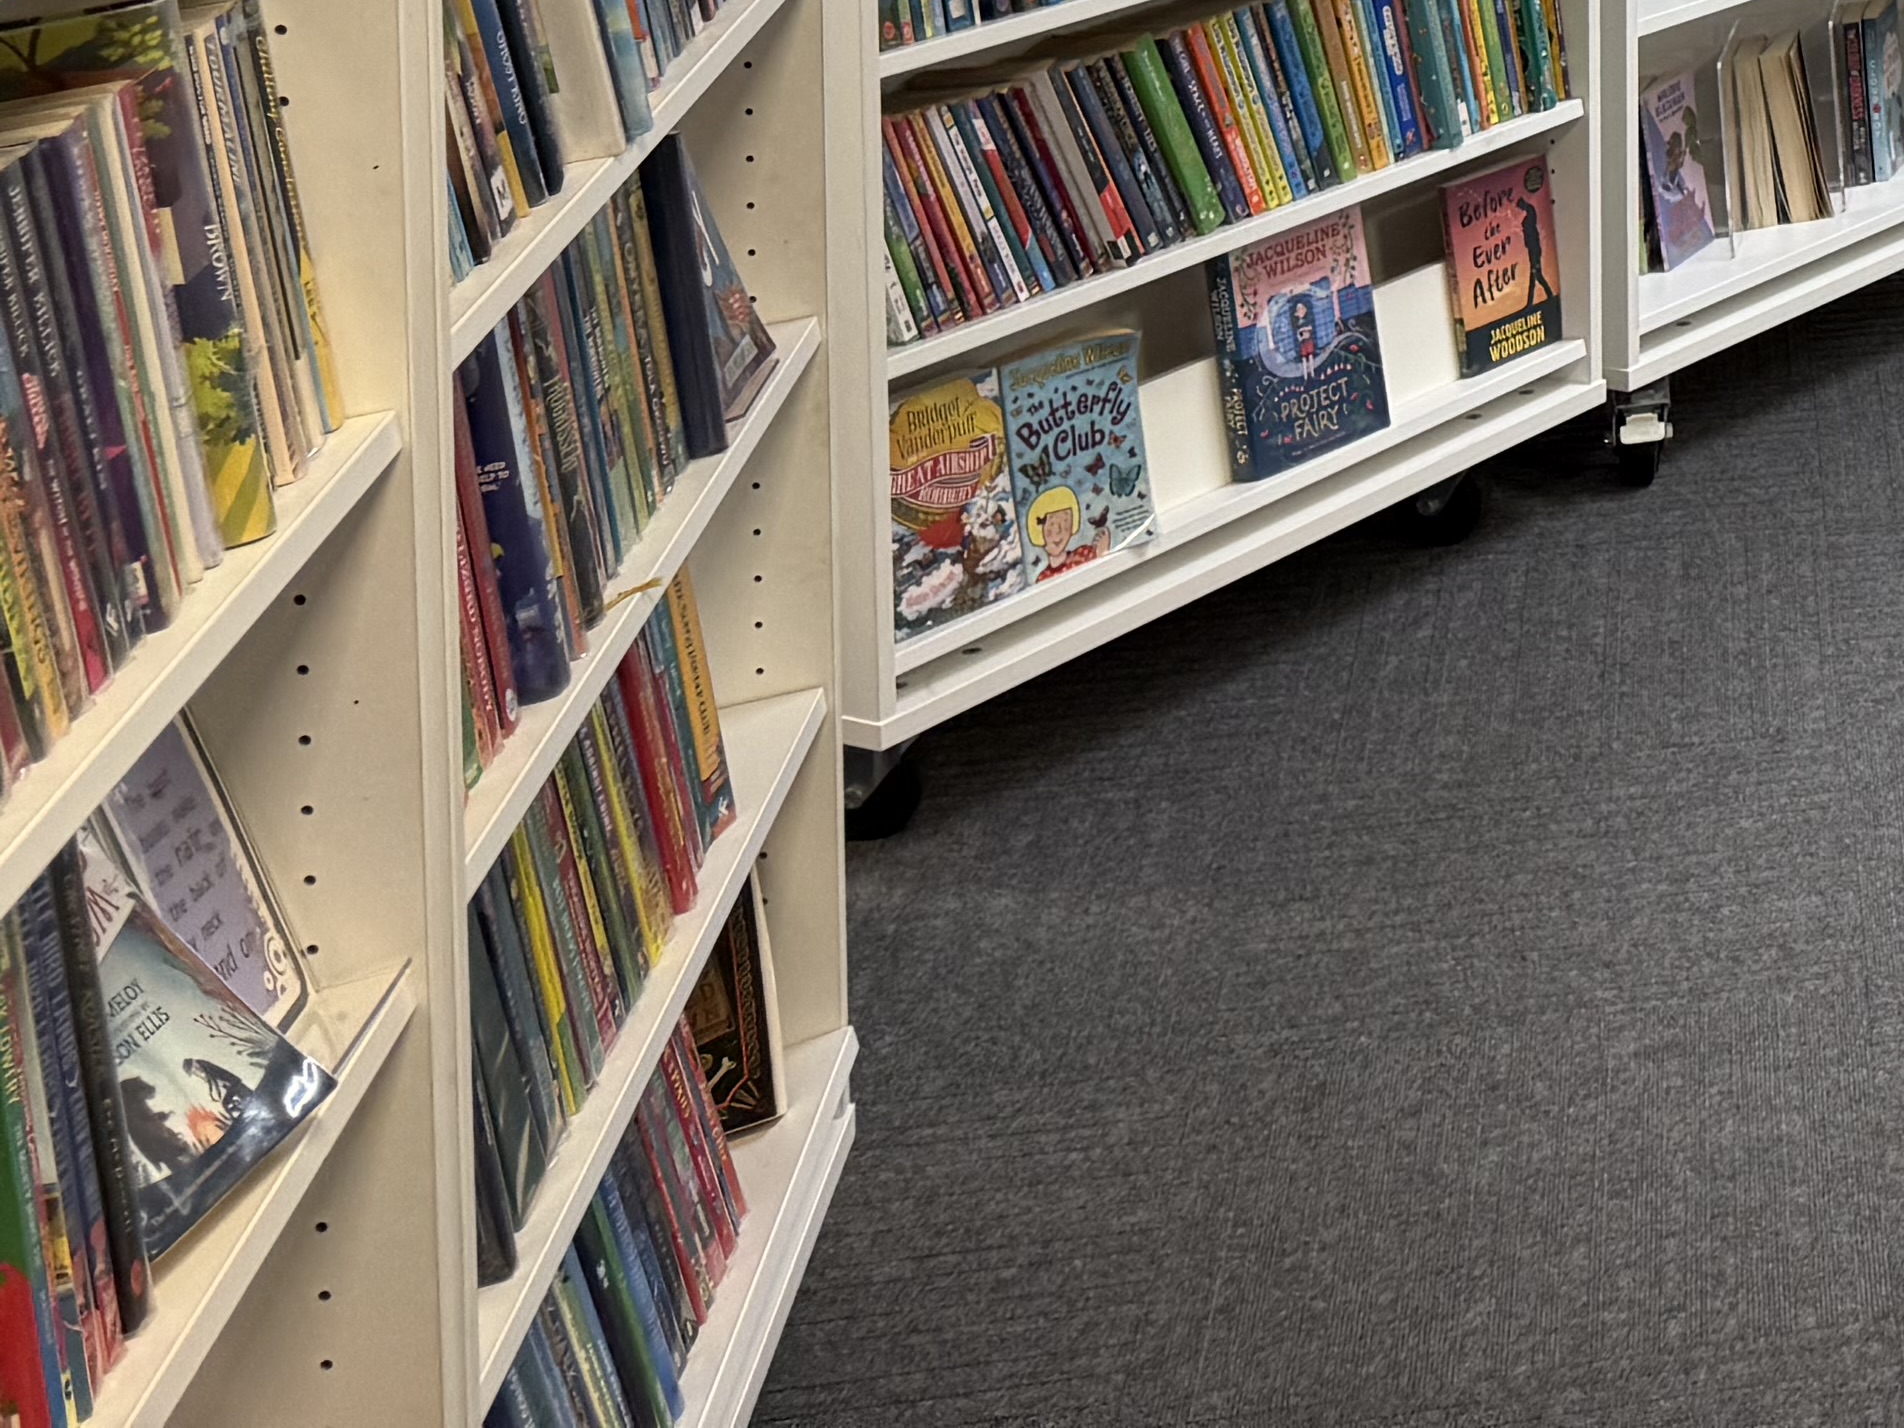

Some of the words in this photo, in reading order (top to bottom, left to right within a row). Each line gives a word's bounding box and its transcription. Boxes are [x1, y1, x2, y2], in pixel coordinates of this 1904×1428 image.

[1459, 186, 1515, 229] Before
[1248, 222, 1341, 268] JACQUELINE
[1484, 221, 1502, 241] the
[197, 221, 241, 302] BROWN
[1262, 245, 1328, 280] WILSON
[1473, 235, 1512, 269] Ever
[1473, 260, 1520, 309] After
[1216, 276, 1236, 352] JACQUELINE
[1490, 310, 1543, 345] JACQUELINE
[29, 290, 65, 378] KILLICK
[1489, 325, 1546, 363] WOODSON
[1010, 354, 1080, 391] Jacqueline
[906, 398, 963, 434] Bridget
[1016, 381, 1131, 451] Butterfly
[1027, 400, 1044, 417] The
[1280, 378, 1350, 423] PROJECT
[1052, 421, 1108, 462] Club
[1294, 404, 1339, 442] FAIRY
[136, 1006, 171, 1044] ELLIS
